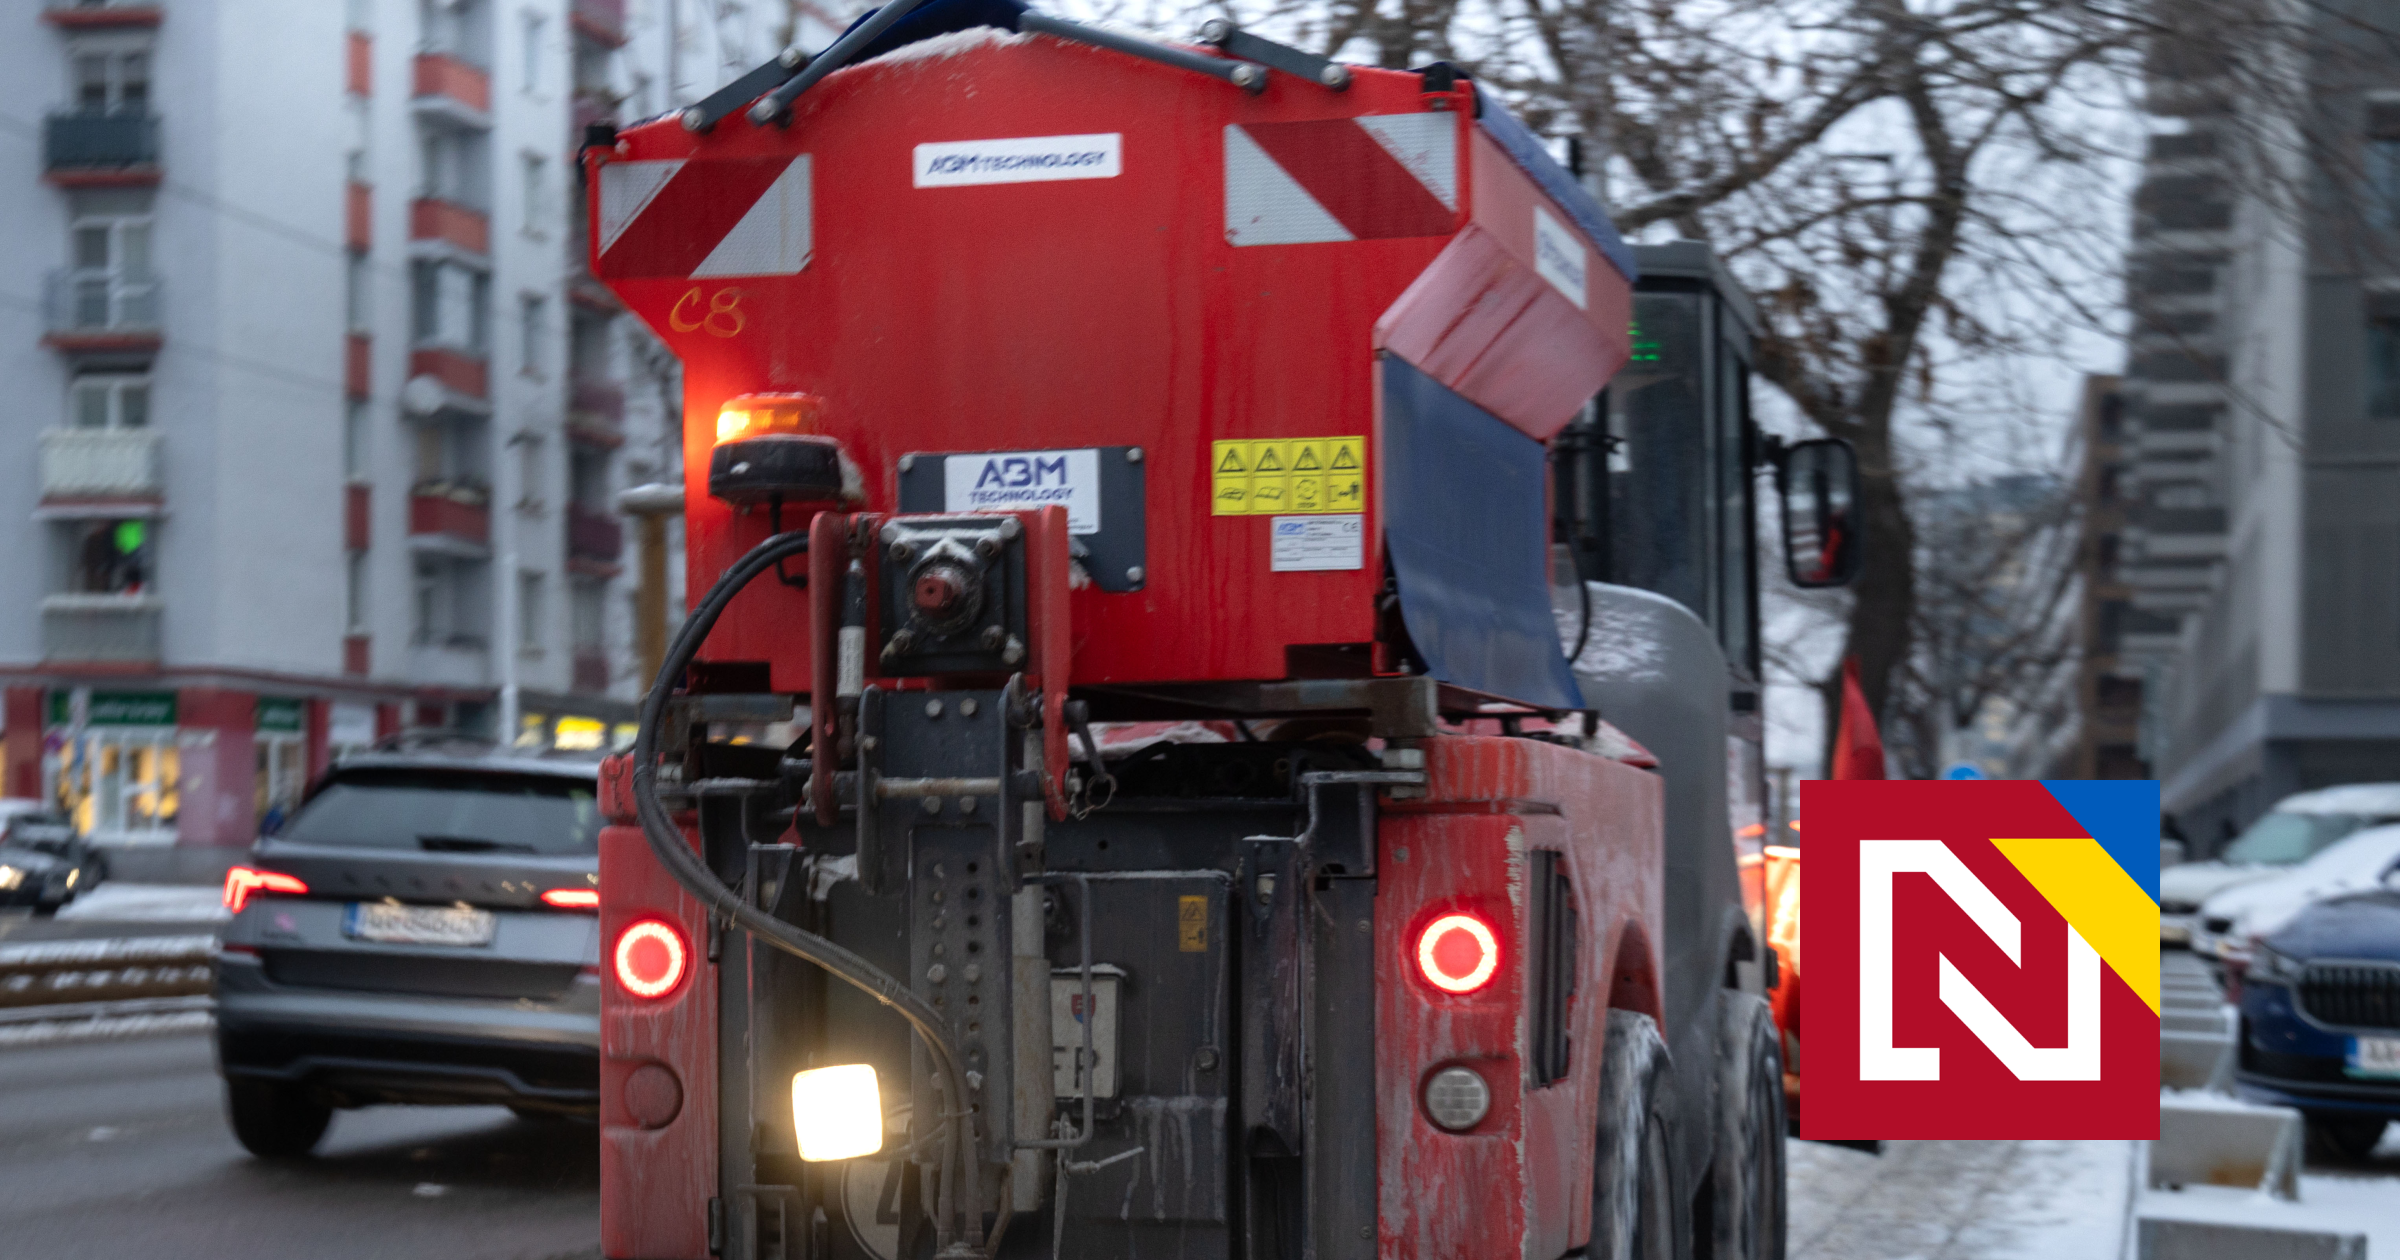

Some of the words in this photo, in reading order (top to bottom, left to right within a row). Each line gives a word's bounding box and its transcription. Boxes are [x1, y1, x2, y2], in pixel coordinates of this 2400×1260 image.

[669, 286, 747, 338] C8
[975, 455, 1067, 488] ABM
[969, 488, 1074, 503] TECHNOLOGY
